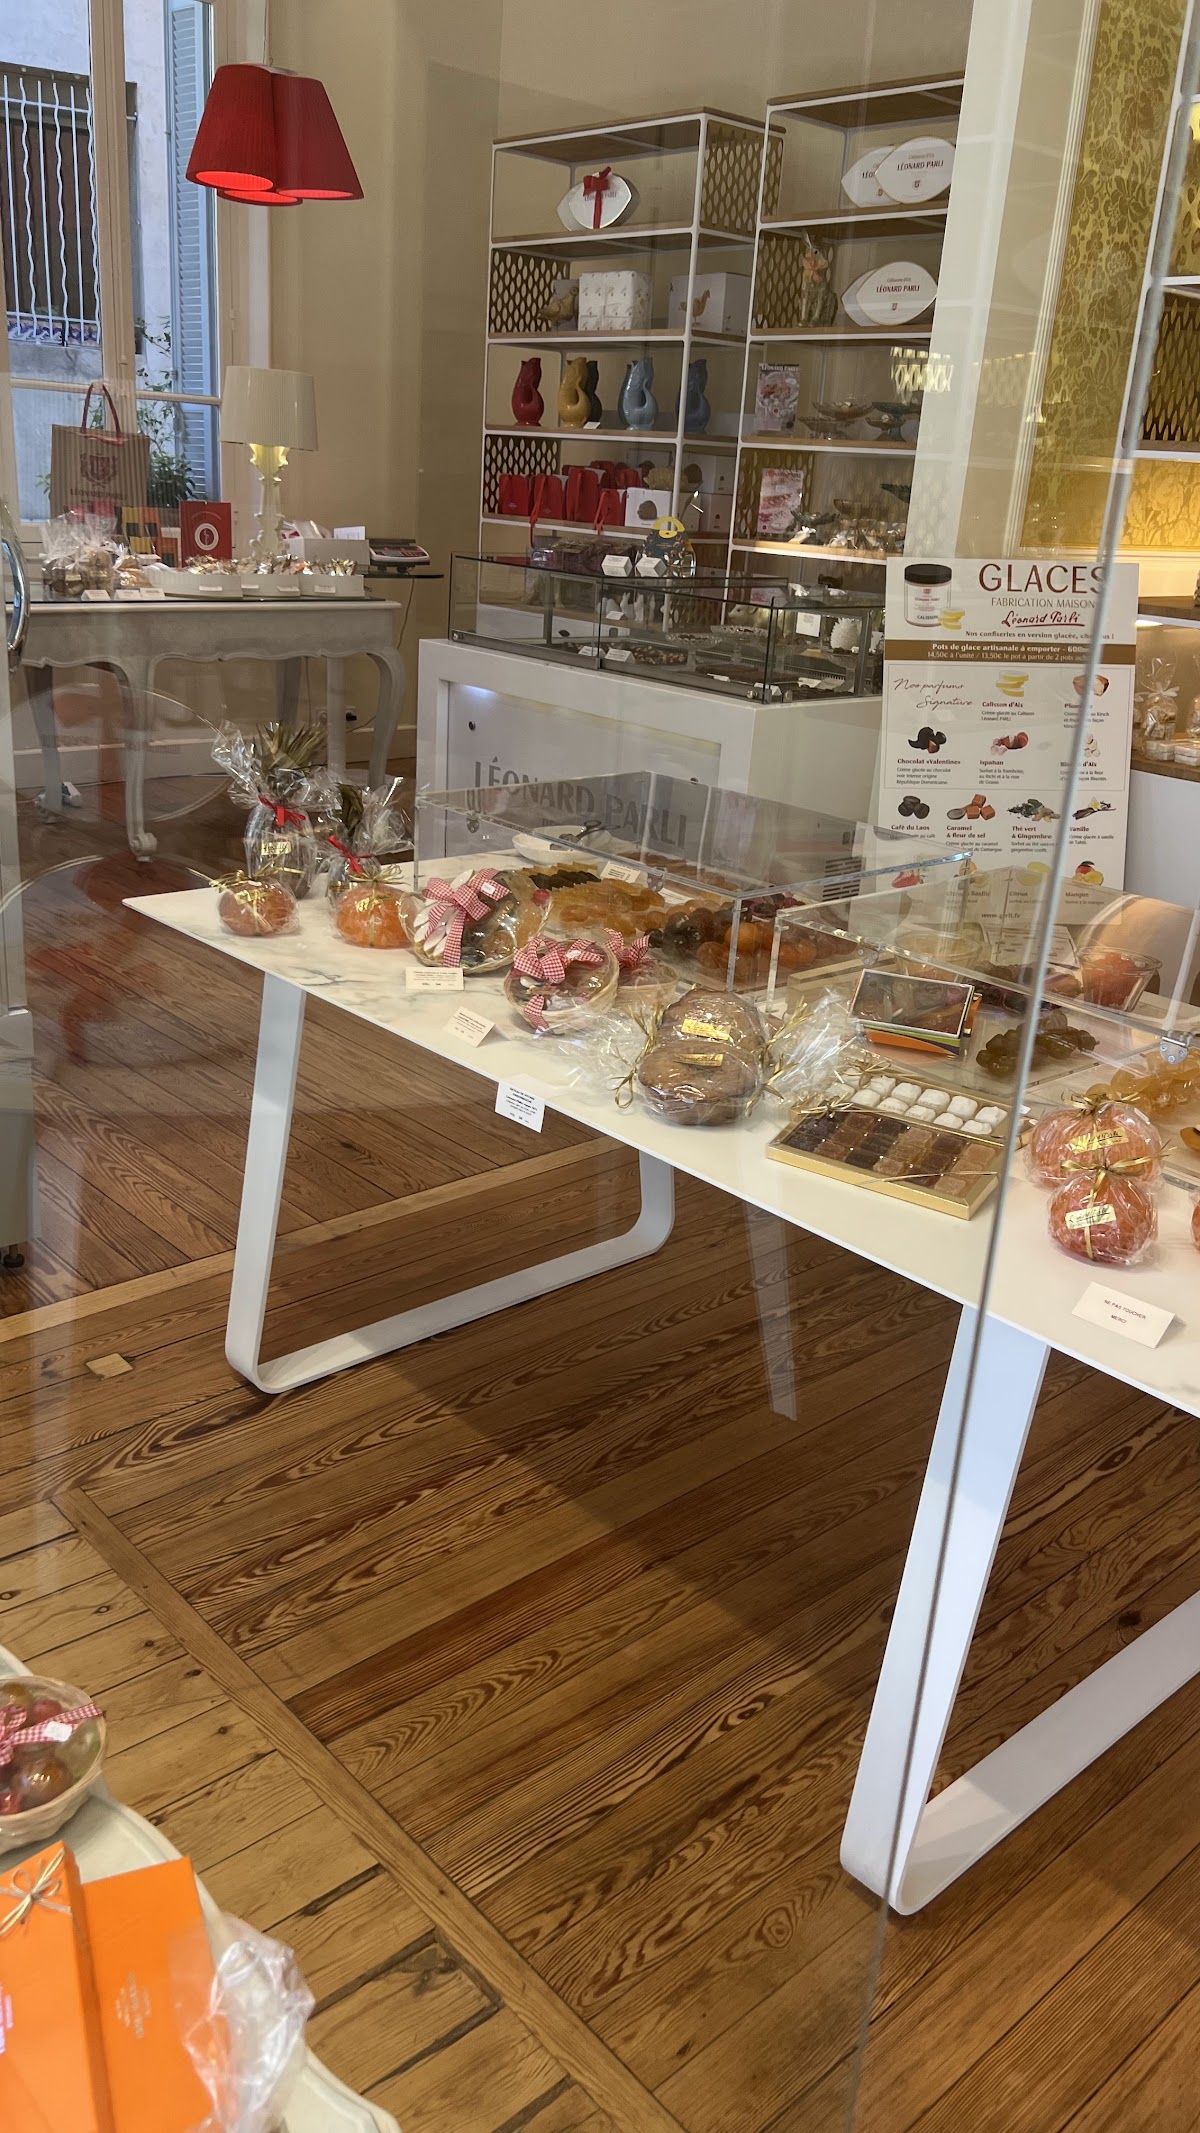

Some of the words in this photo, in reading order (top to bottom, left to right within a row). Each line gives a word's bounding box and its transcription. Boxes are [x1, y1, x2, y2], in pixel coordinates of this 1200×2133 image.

[897, 161, 926, 172] LÉONARD
[926, 160, 944, 168] PARLI
[903, 284, 920, 292] PARLI
[979, 563, 1106, 594] GLACES
[991, 597, 1054, 608] FABRICATION
[1056, 599, 1096, 608] MAISON
[1001, 610, 1048, 628] Léonard
[965, 630, 978, 638] Nos
[1027, 632, 1052, 640] version
[1053, 632, 1078, 640] glacée,
[961, 643, 982, 652] glace
[982, 644, 1020, 652] artisanale
[1027, 645, 1062, 654] emporter
[916, 695, 974, 712] Signature
[897, 758, 926, 766] Chocolat
[979, 760, 1004, 768] Ispahan
[891, 824, 906, 832] Café
[1123, 1307, 1146, 1320] TOUCHER
